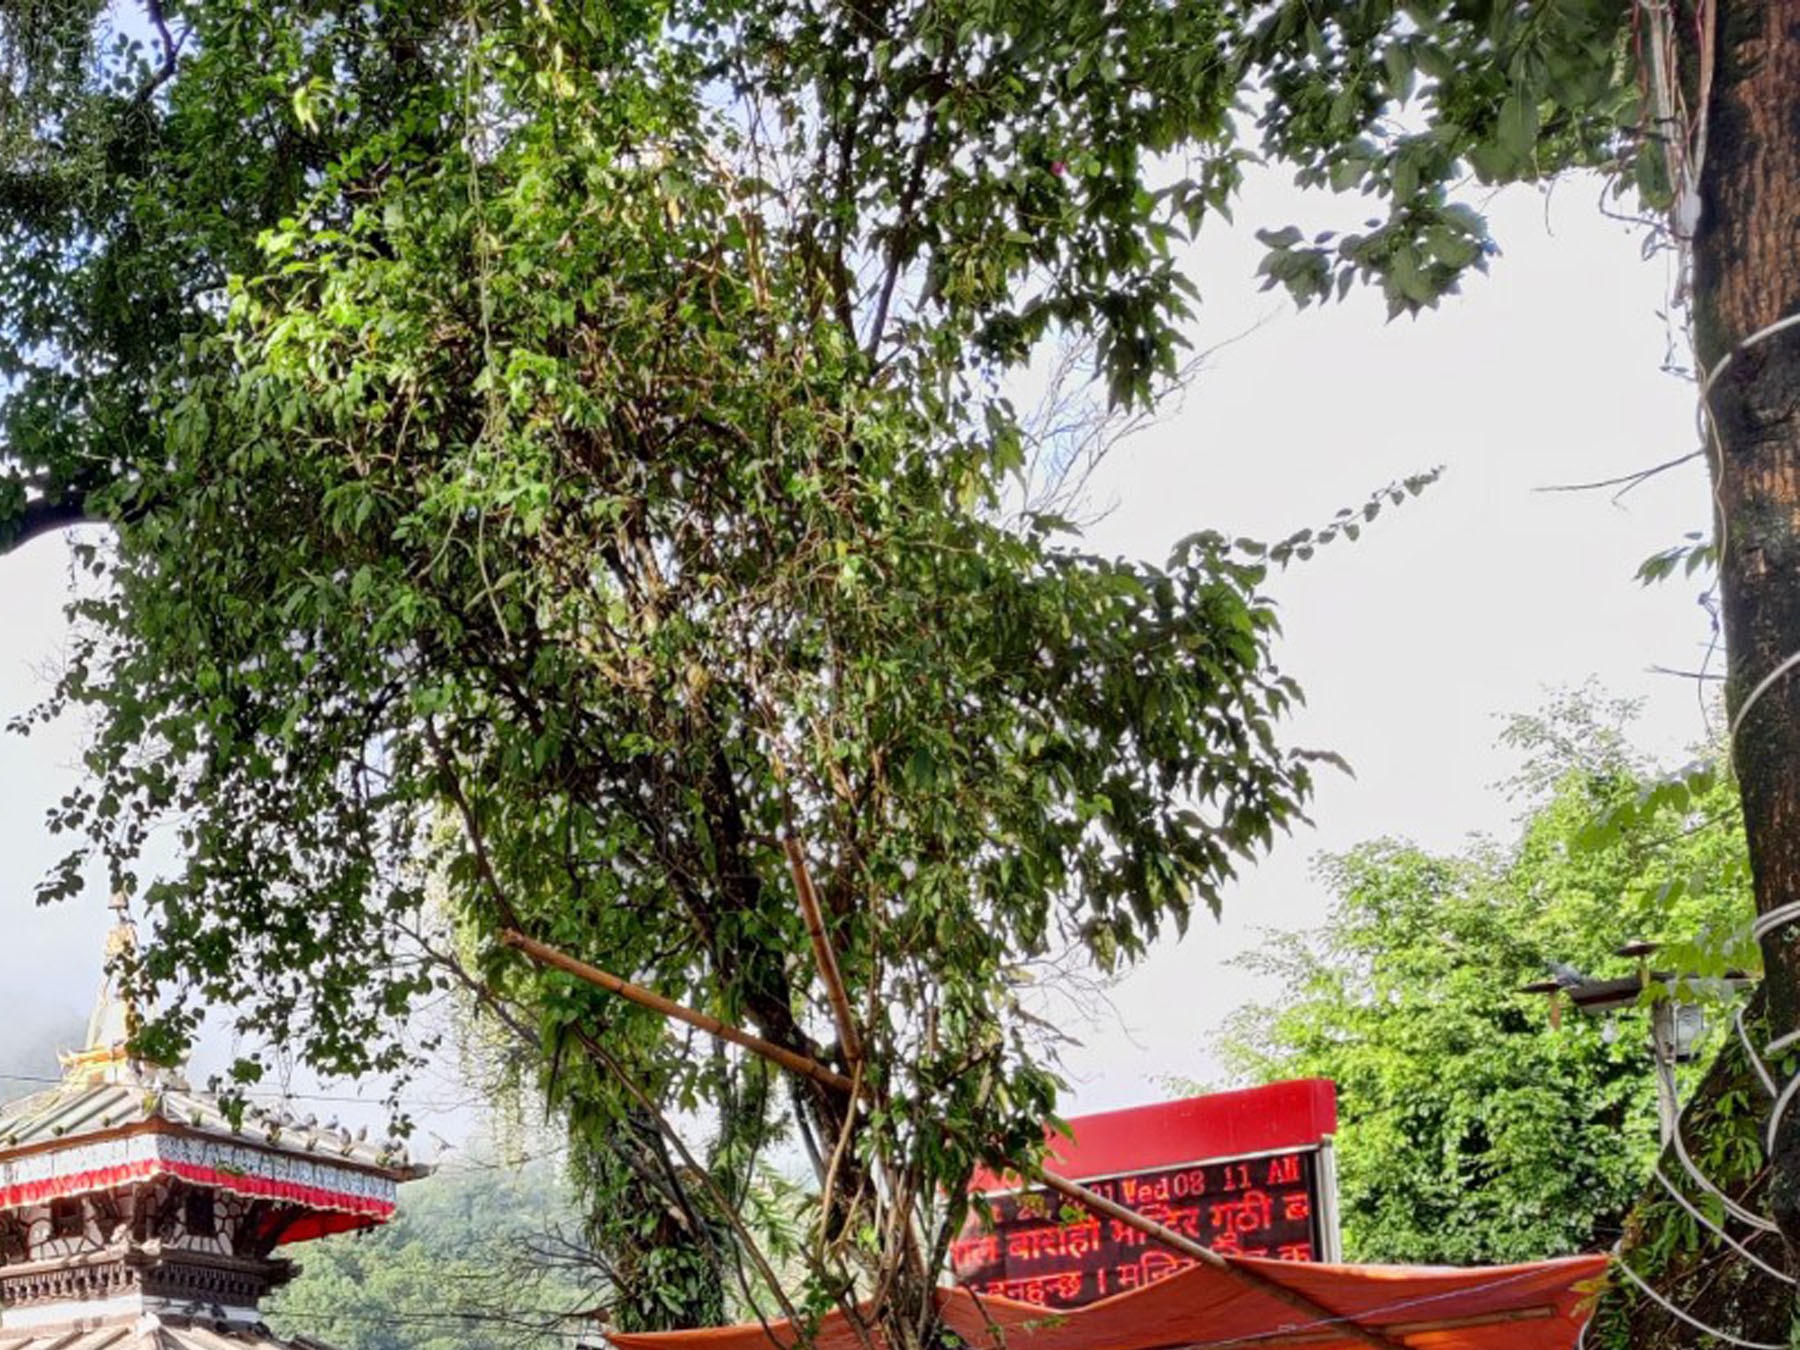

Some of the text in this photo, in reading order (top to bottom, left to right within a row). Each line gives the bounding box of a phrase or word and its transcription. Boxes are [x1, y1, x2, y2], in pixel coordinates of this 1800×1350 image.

[1122, 1180, 1170, 1202] Wed
[1173, 1171, 1205, 1197] 08
[1222, 1164, 1250, 1191] 11
